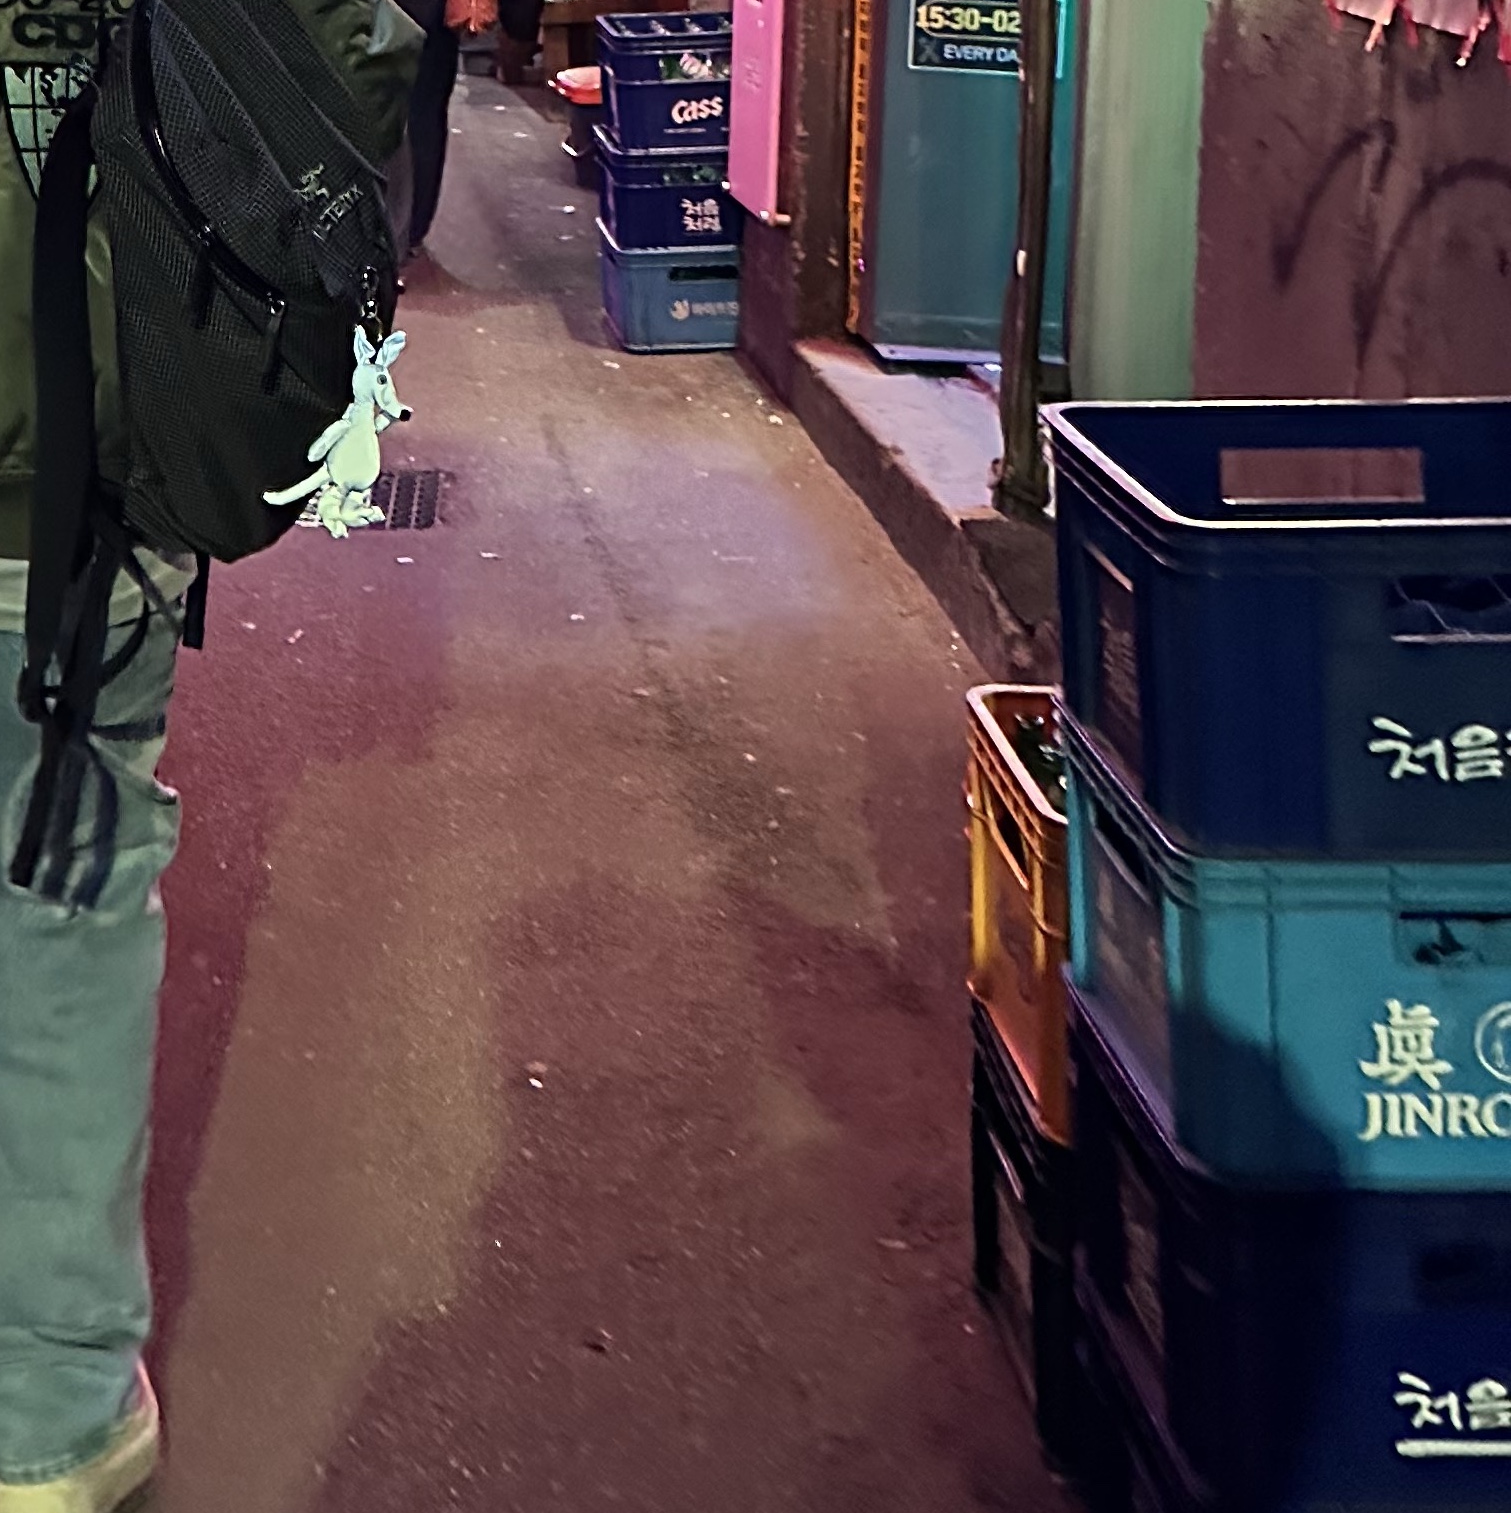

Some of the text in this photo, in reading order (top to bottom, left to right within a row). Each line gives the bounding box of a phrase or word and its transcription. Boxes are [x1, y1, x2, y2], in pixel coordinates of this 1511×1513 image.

[11, 14, 128, 51] CD
[943, 43, 995, 63] EVERY
[671, 95, 724, 124] Cass
[1367, 716, 1511, 782] 처음
[1358, 998, 1455, 1091] 眞
